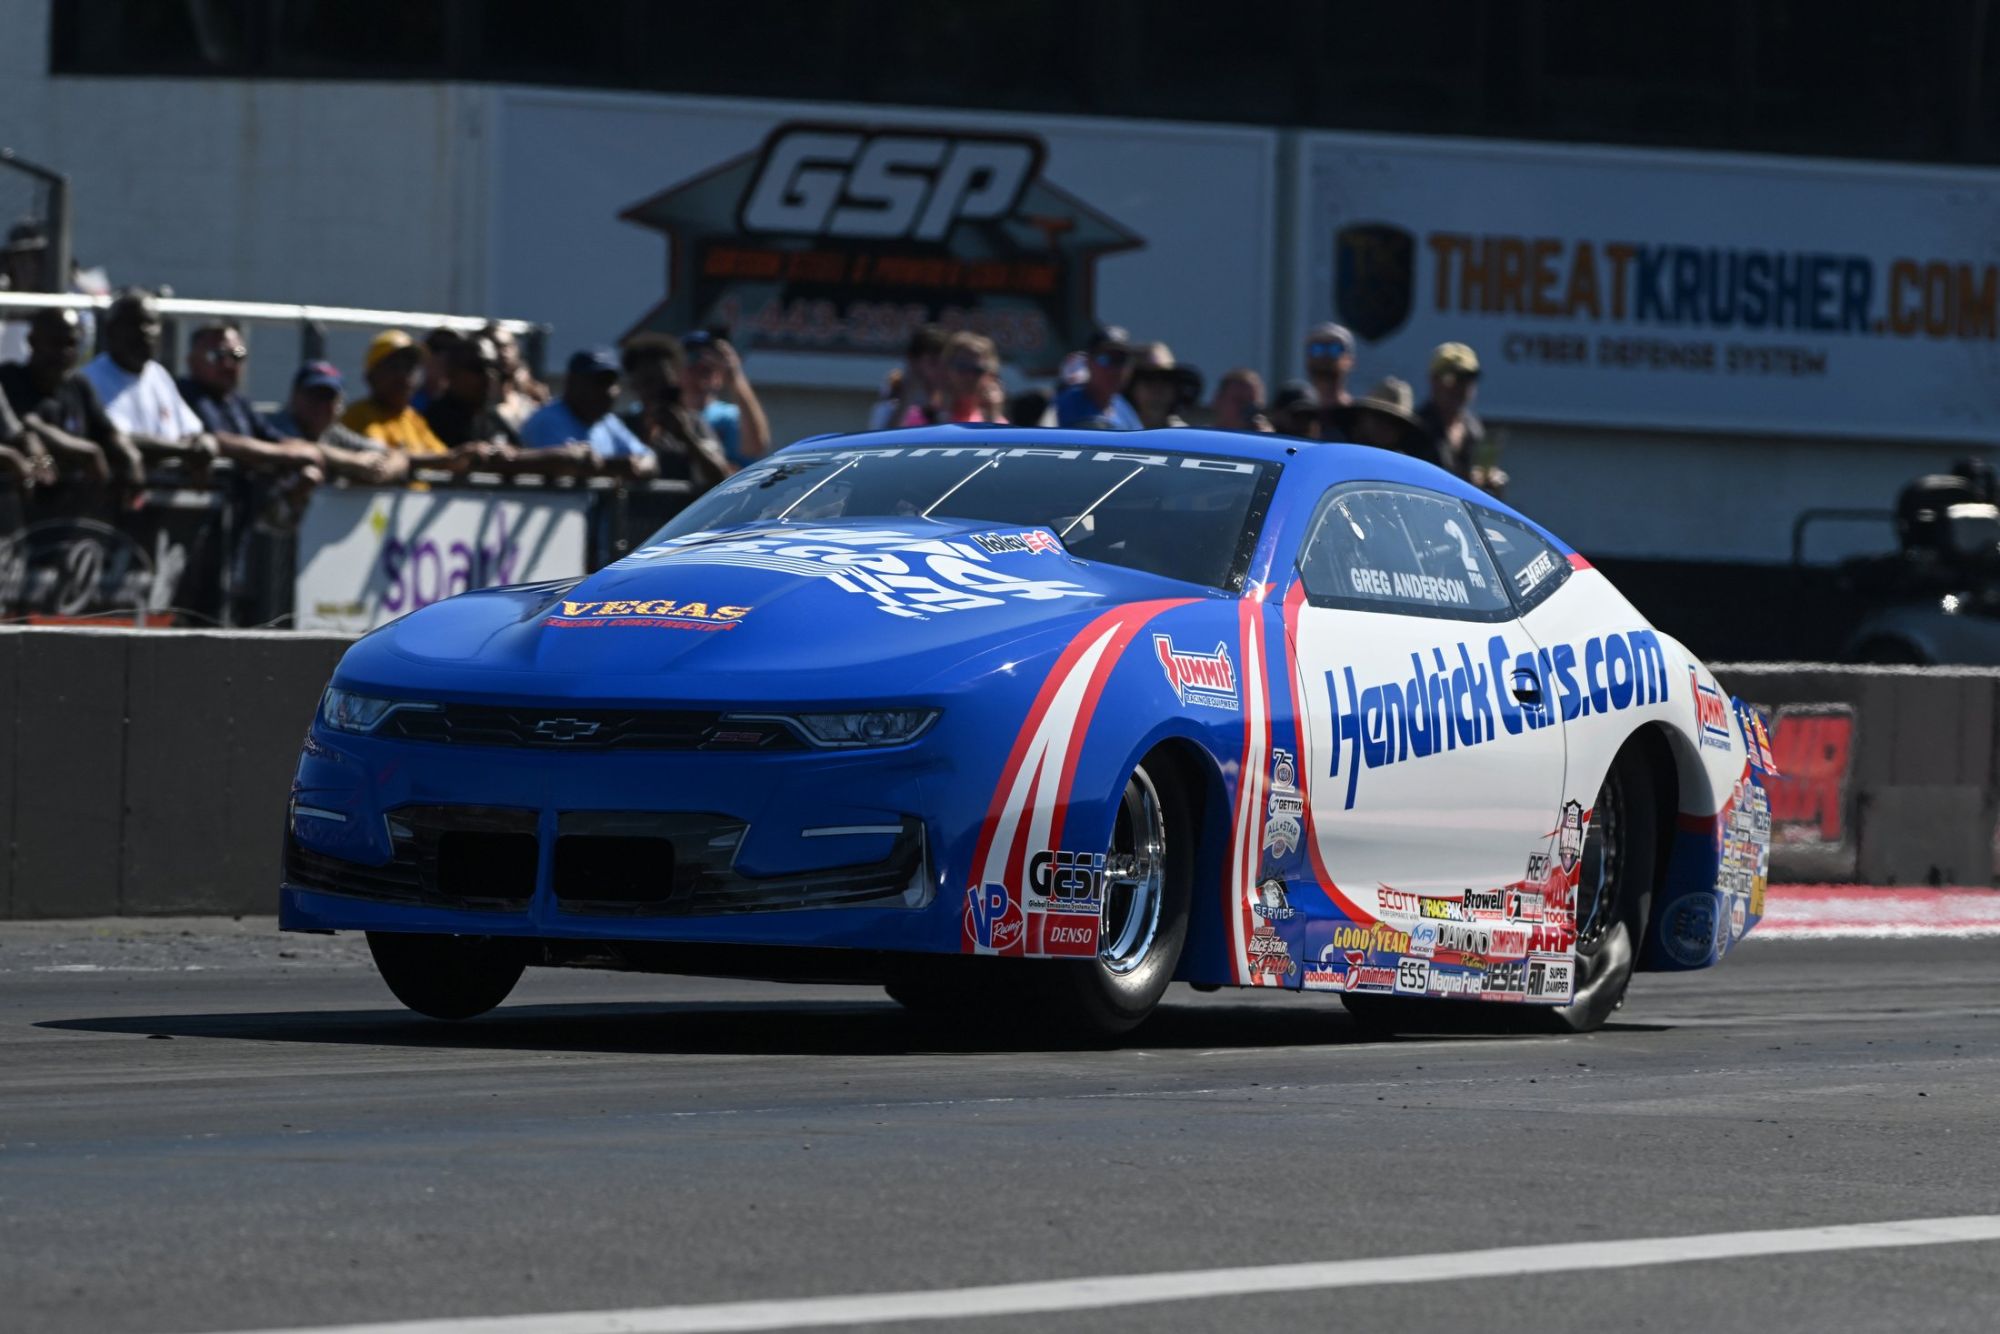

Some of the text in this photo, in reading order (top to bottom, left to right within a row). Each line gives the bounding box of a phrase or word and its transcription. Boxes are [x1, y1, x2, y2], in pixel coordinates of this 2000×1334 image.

[742, 130, 1031, 241] GSP
[1428, 233, 1998, 342] THREATKRUSHER.COM
[1502, 332, 1827, 376] CYBER DEFENSE SYSTEM
[765, 448, 1258, 475] CAMARO
[1444, 519, 1480, 572] 2
[1351, 567, 1470, 604] GREG ANDERSON
[562, 599, 753, 620] VEGAS
[1156, 637, 1235, 703] SUMMIT
[1377, 889, 1416, 912] SCOTT
[1463, 888, 1505, 909] Browell
[967, 881, 1009, 949] VP
[1255, 905, 1295, 920] SERVICE
[1545, 912, 1575, 925] TOOLS
[993, 920, 1024, 942] Racing
[1050, 926, 1092, 943] DENSO
[1437, 923, 1489, 955] DIAMOND
[1491, 930, 1525, 954] SIMPSON
[1528, 925, 1577, 953] ARP
[1268, 940, 1288, 953] STAR
[1429, 970, 1484, 997] MagnaFuel
[1481, 963, 1525, 992] JESEL
[1527, 963, 1546, 995] ATI
[1549, 967, 1567, 979] SUPER
[1545, 981, 1569, 993] DAMPER
